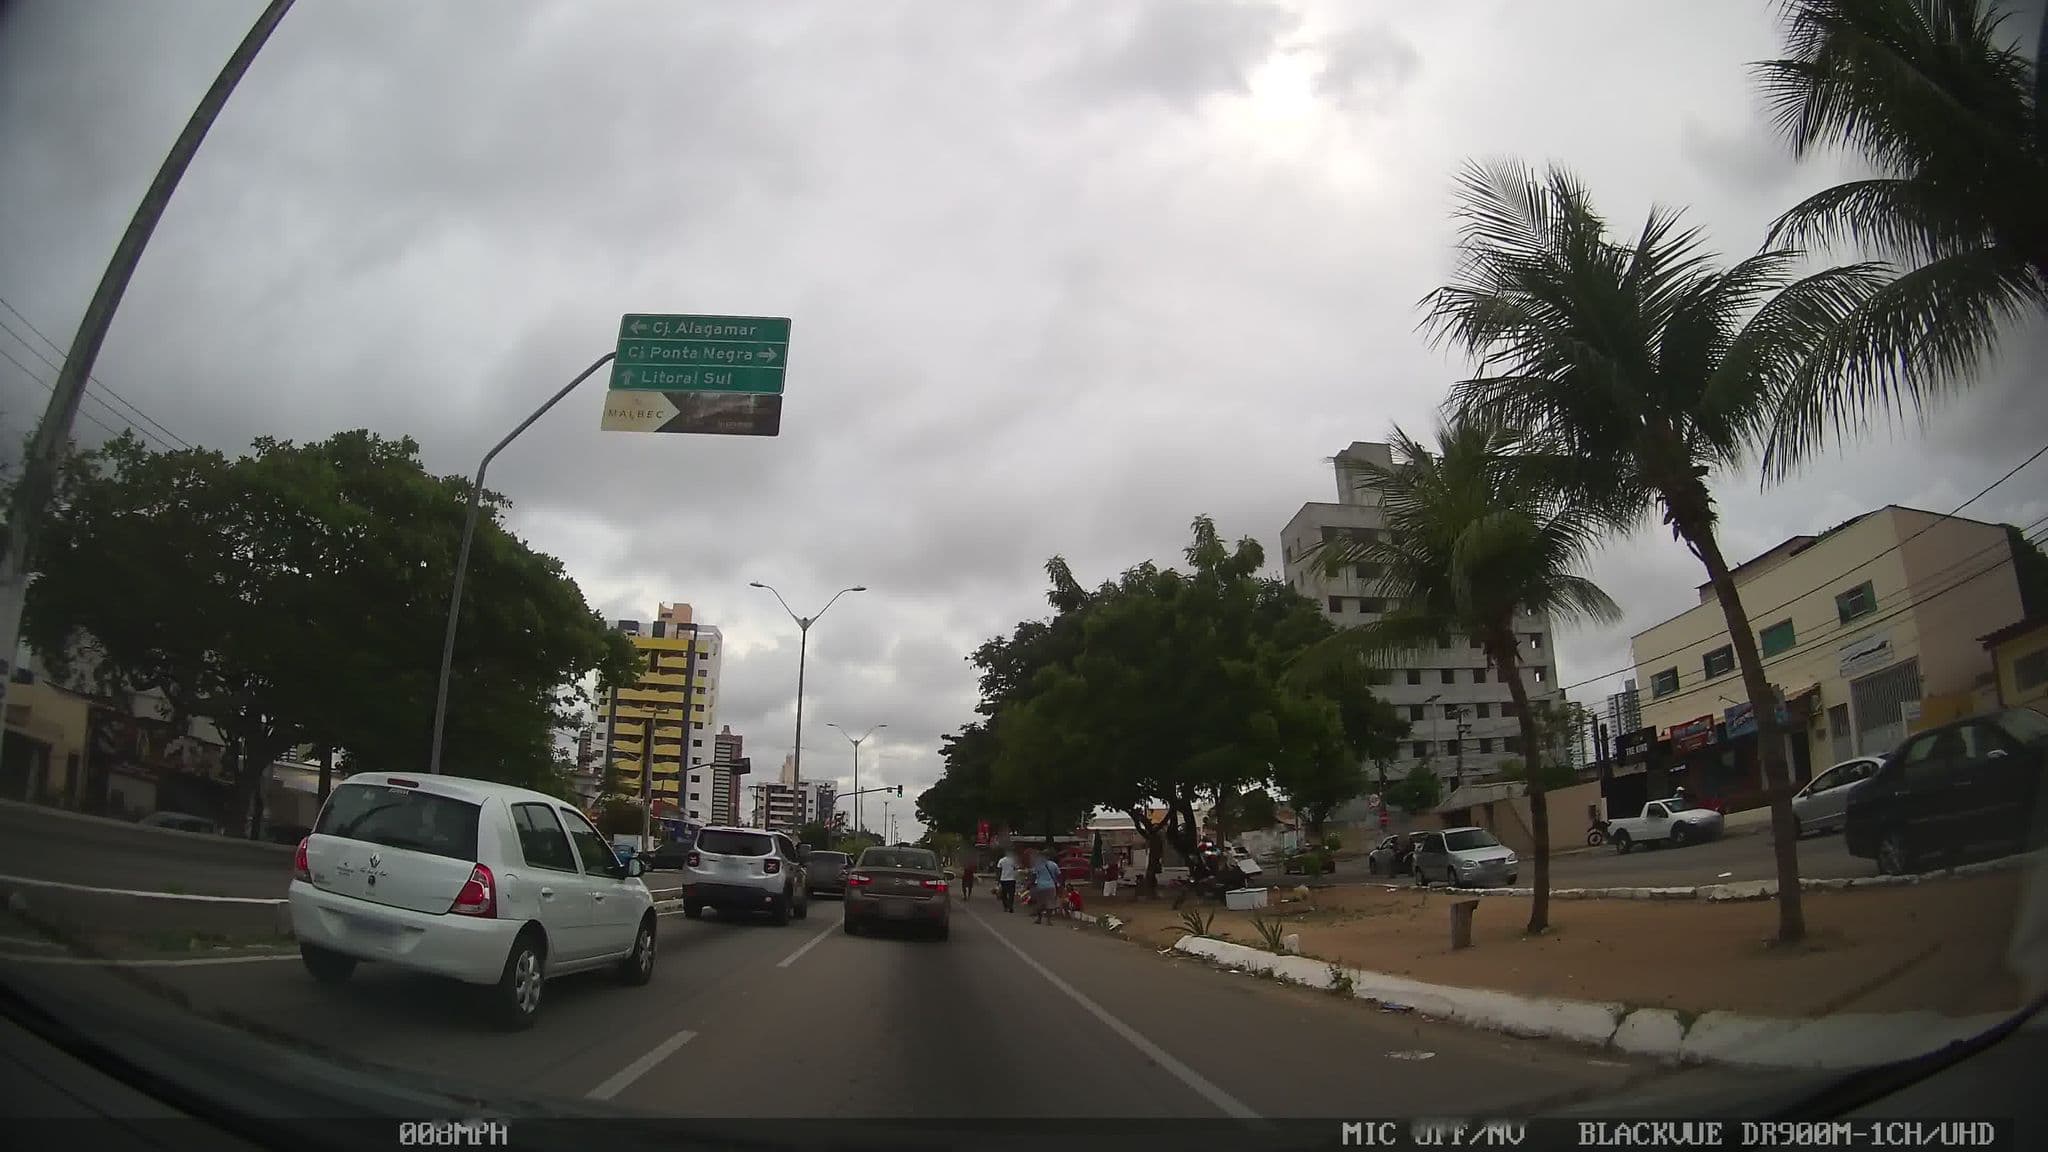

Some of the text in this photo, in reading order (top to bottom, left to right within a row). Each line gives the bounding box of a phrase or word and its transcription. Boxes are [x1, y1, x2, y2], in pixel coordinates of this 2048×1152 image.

[676, 322, 757, 337] Alagamar
[650, 346, 698, 359] Ponta
[703, 347, 753, 363] Negra
[641, 371, 732, 385] Litoral Sul
[608, 408, 665, 419] MALBEC
